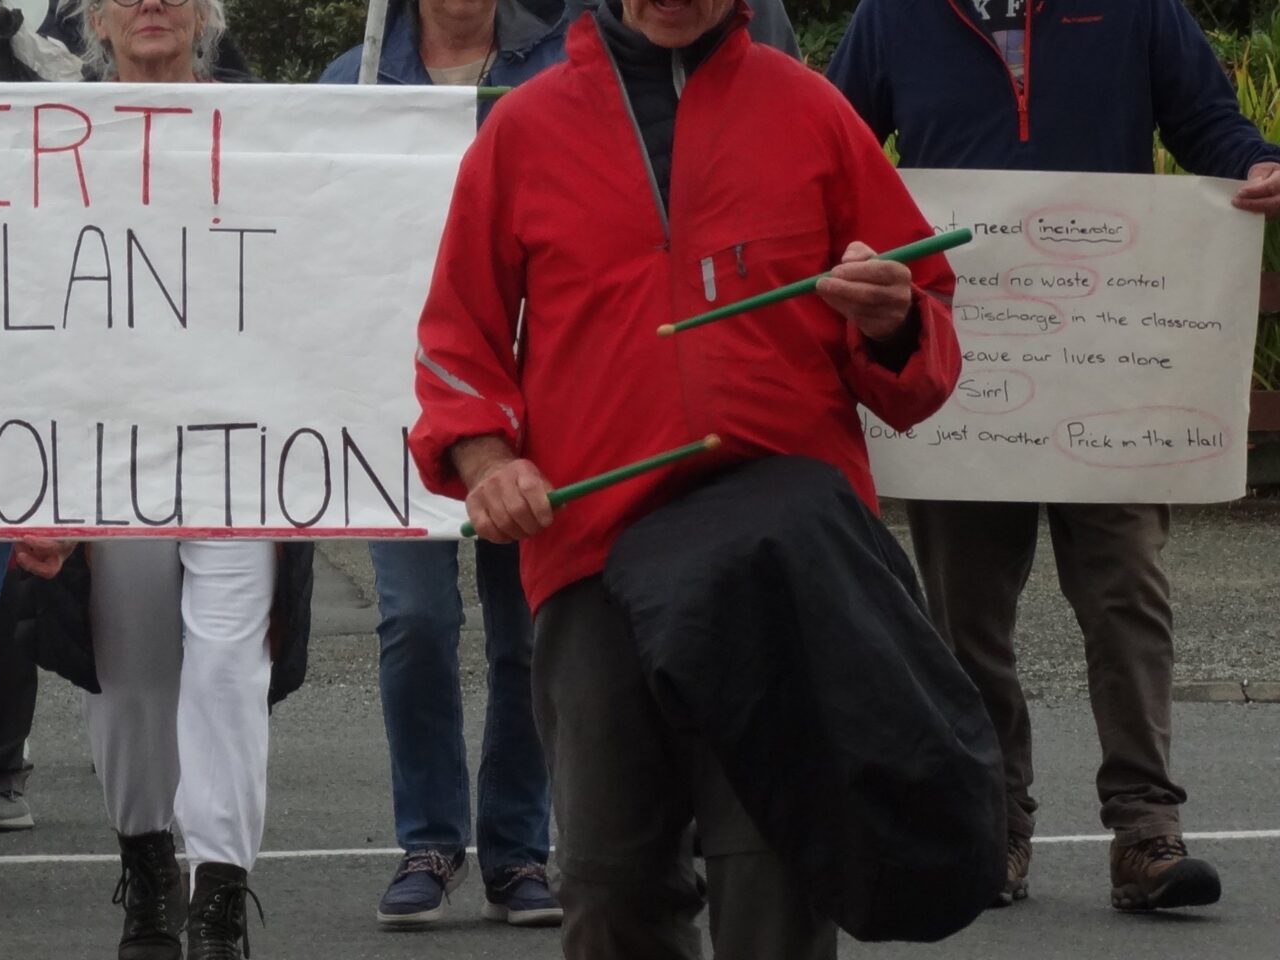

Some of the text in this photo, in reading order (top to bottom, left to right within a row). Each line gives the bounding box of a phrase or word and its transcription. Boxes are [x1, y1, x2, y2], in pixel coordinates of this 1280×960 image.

[974, 220, 1022, 236] need
[1037, 217, 1124, 236] incinerator
[956, 272, 1166, 291] need no waste control
[959, 304, 1223, 332] Discharge in the classroom
[962, 347, 1174, 370] eave our lives alone
[928, 424, 969, 446] just
[978, 429, 1050, 447] another
[1066, 421, 1113, 449] Prick
[1141, 430, 1175, 448] the
[1186, 427, 1224, 449] Hall
